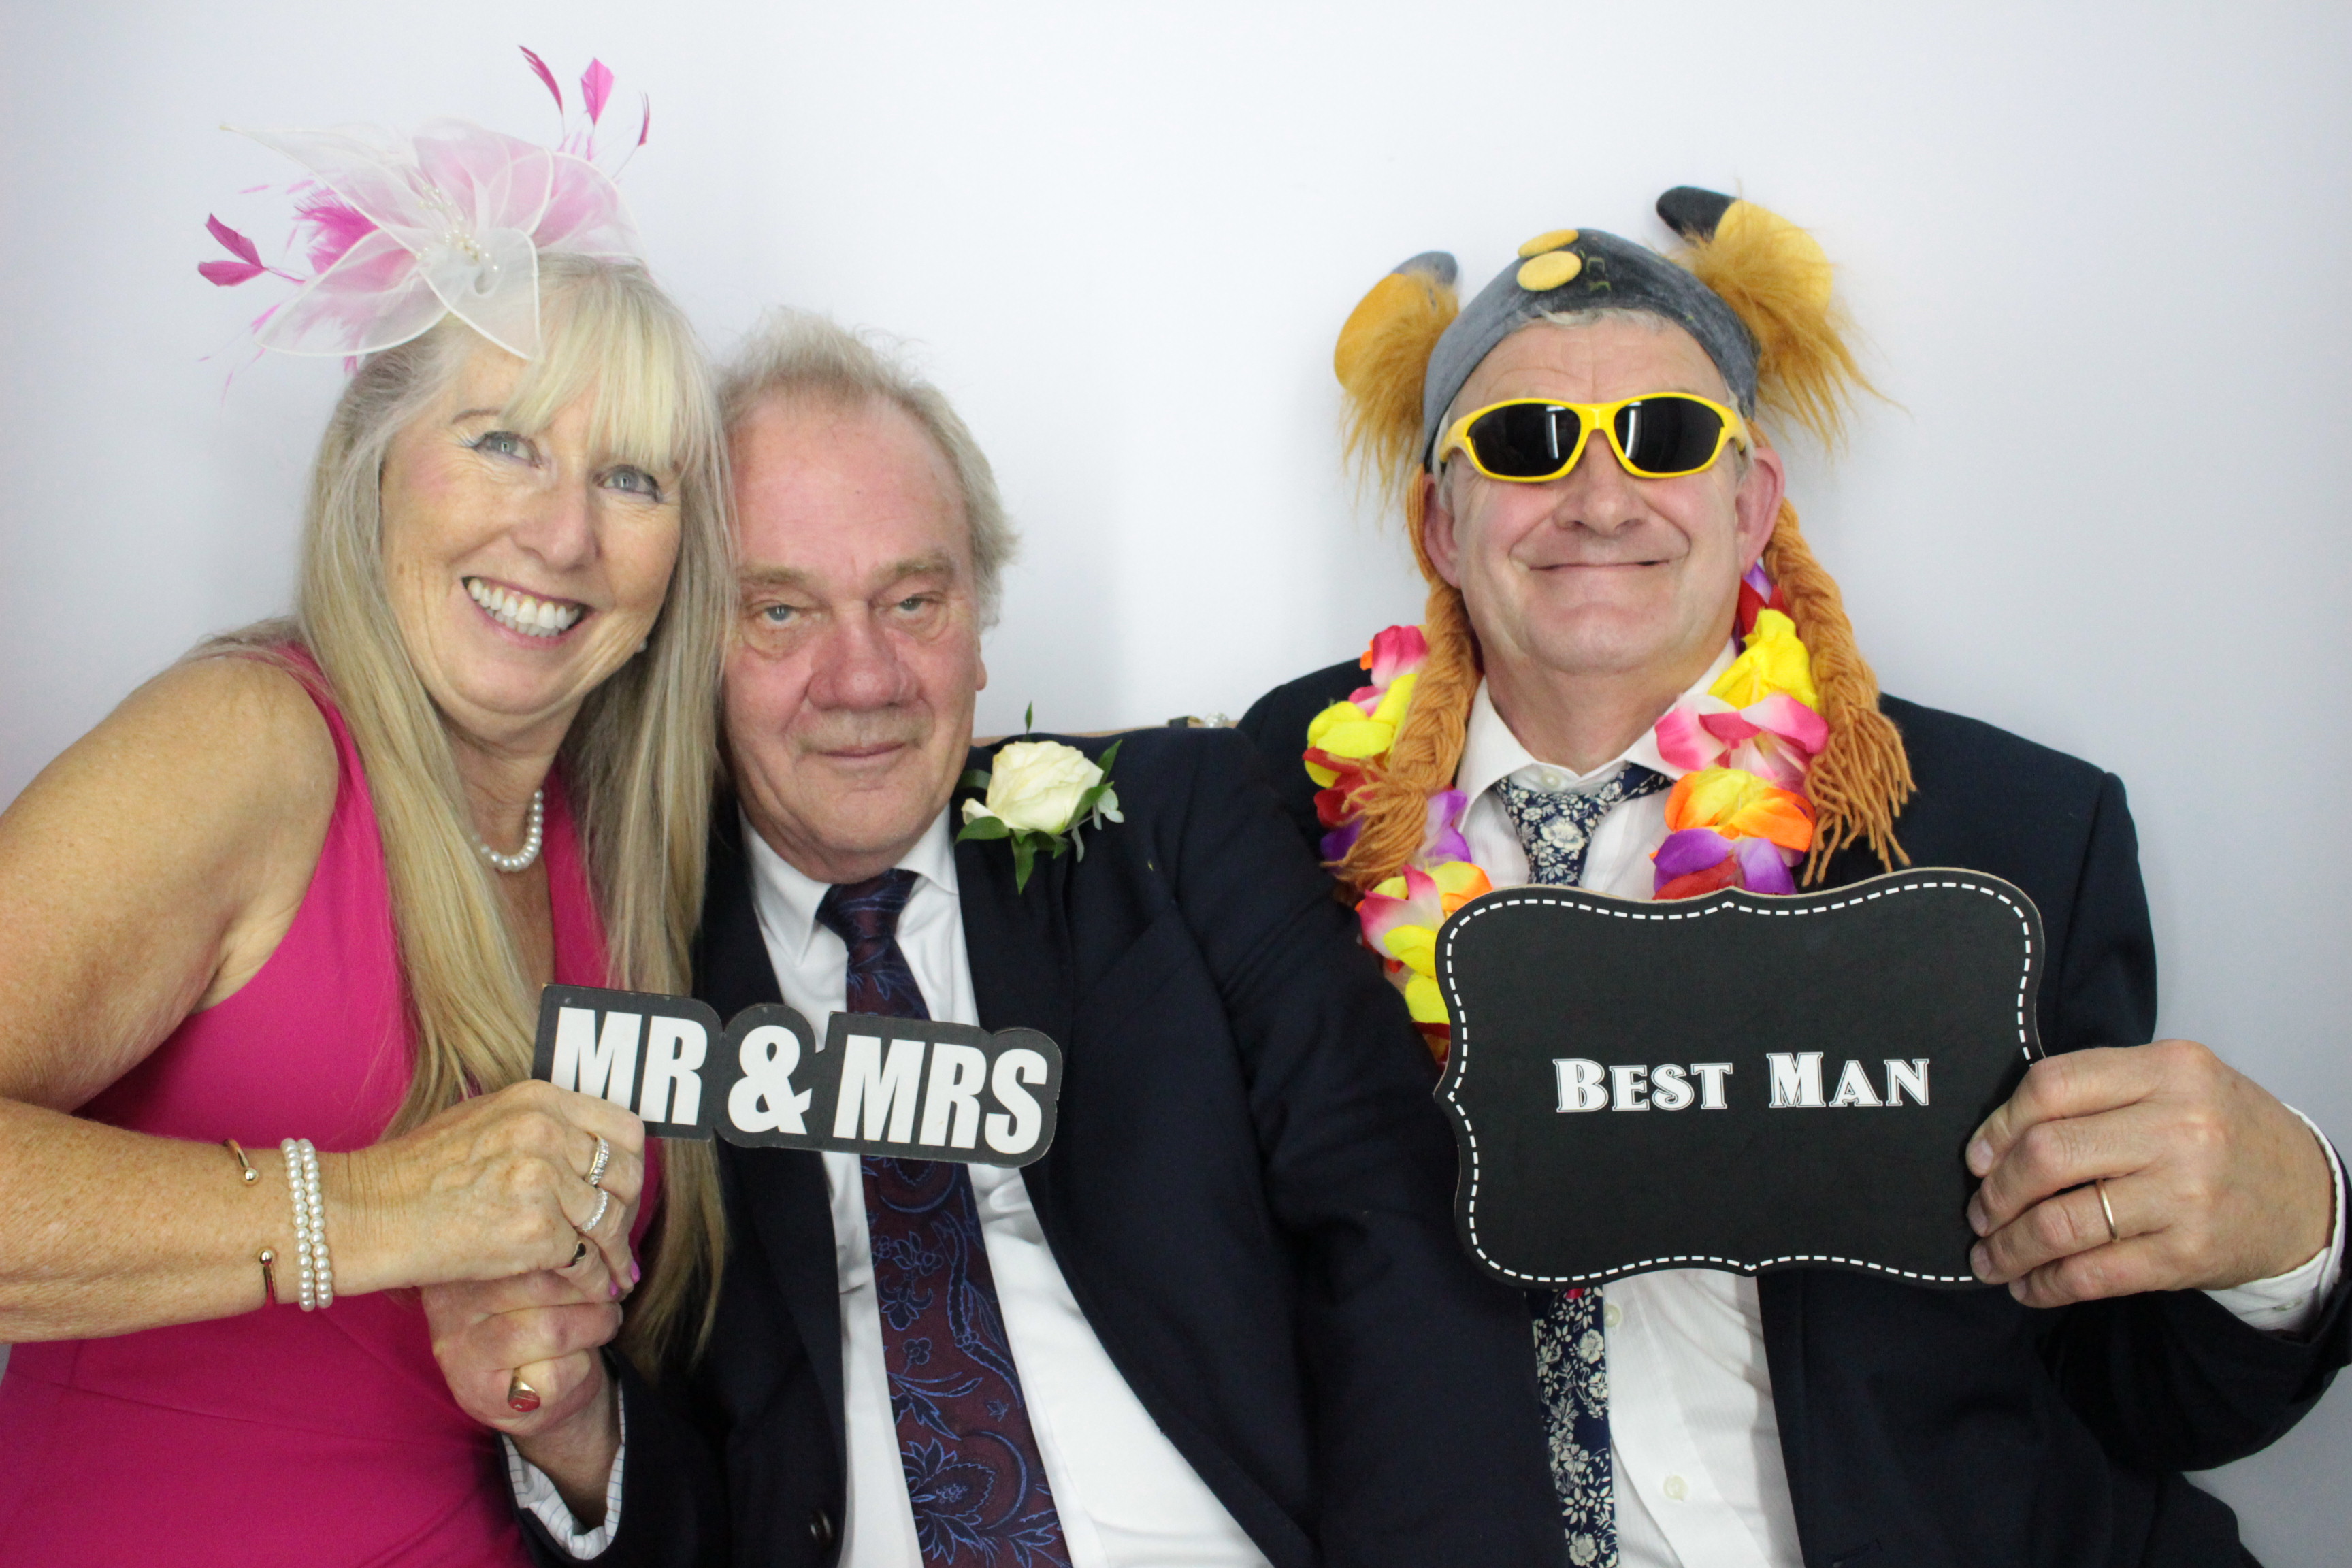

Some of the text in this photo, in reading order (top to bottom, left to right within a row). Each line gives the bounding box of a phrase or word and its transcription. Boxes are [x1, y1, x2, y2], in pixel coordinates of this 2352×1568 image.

[551, 1007, 1049, 1155] MR & MRS
[1552, 1051, 1930, 1113] BEST MAN
